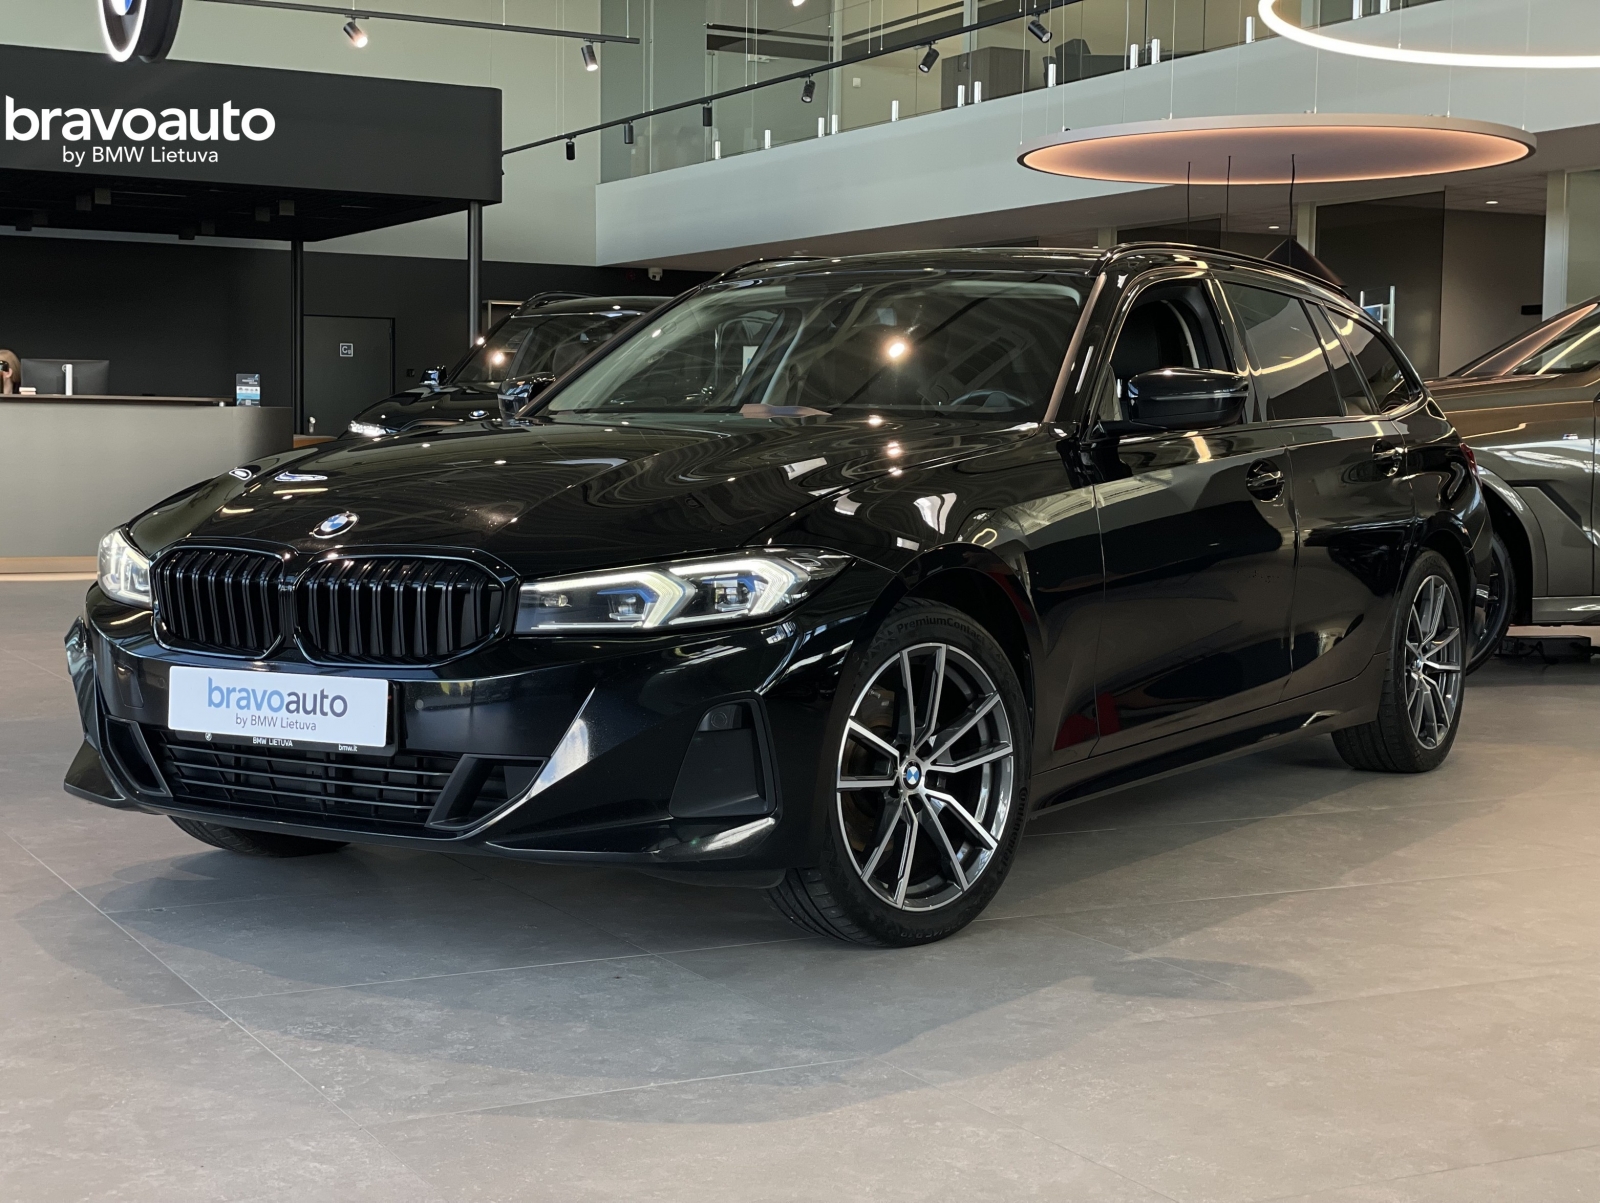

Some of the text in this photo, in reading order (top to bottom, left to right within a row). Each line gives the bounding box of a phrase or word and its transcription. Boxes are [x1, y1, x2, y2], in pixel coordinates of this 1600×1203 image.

[5, 94, 277, 142] bravoauto
[62, 145, 219, 168] by BMW Lietuva
[896, 615, 985, 645] PremiumContact
[207, 676, 348, 718] bravoauto
[235, 712, 317, 732] by BMW Lietuva
[252, 736, 293, 747] BMW LIETUVA
